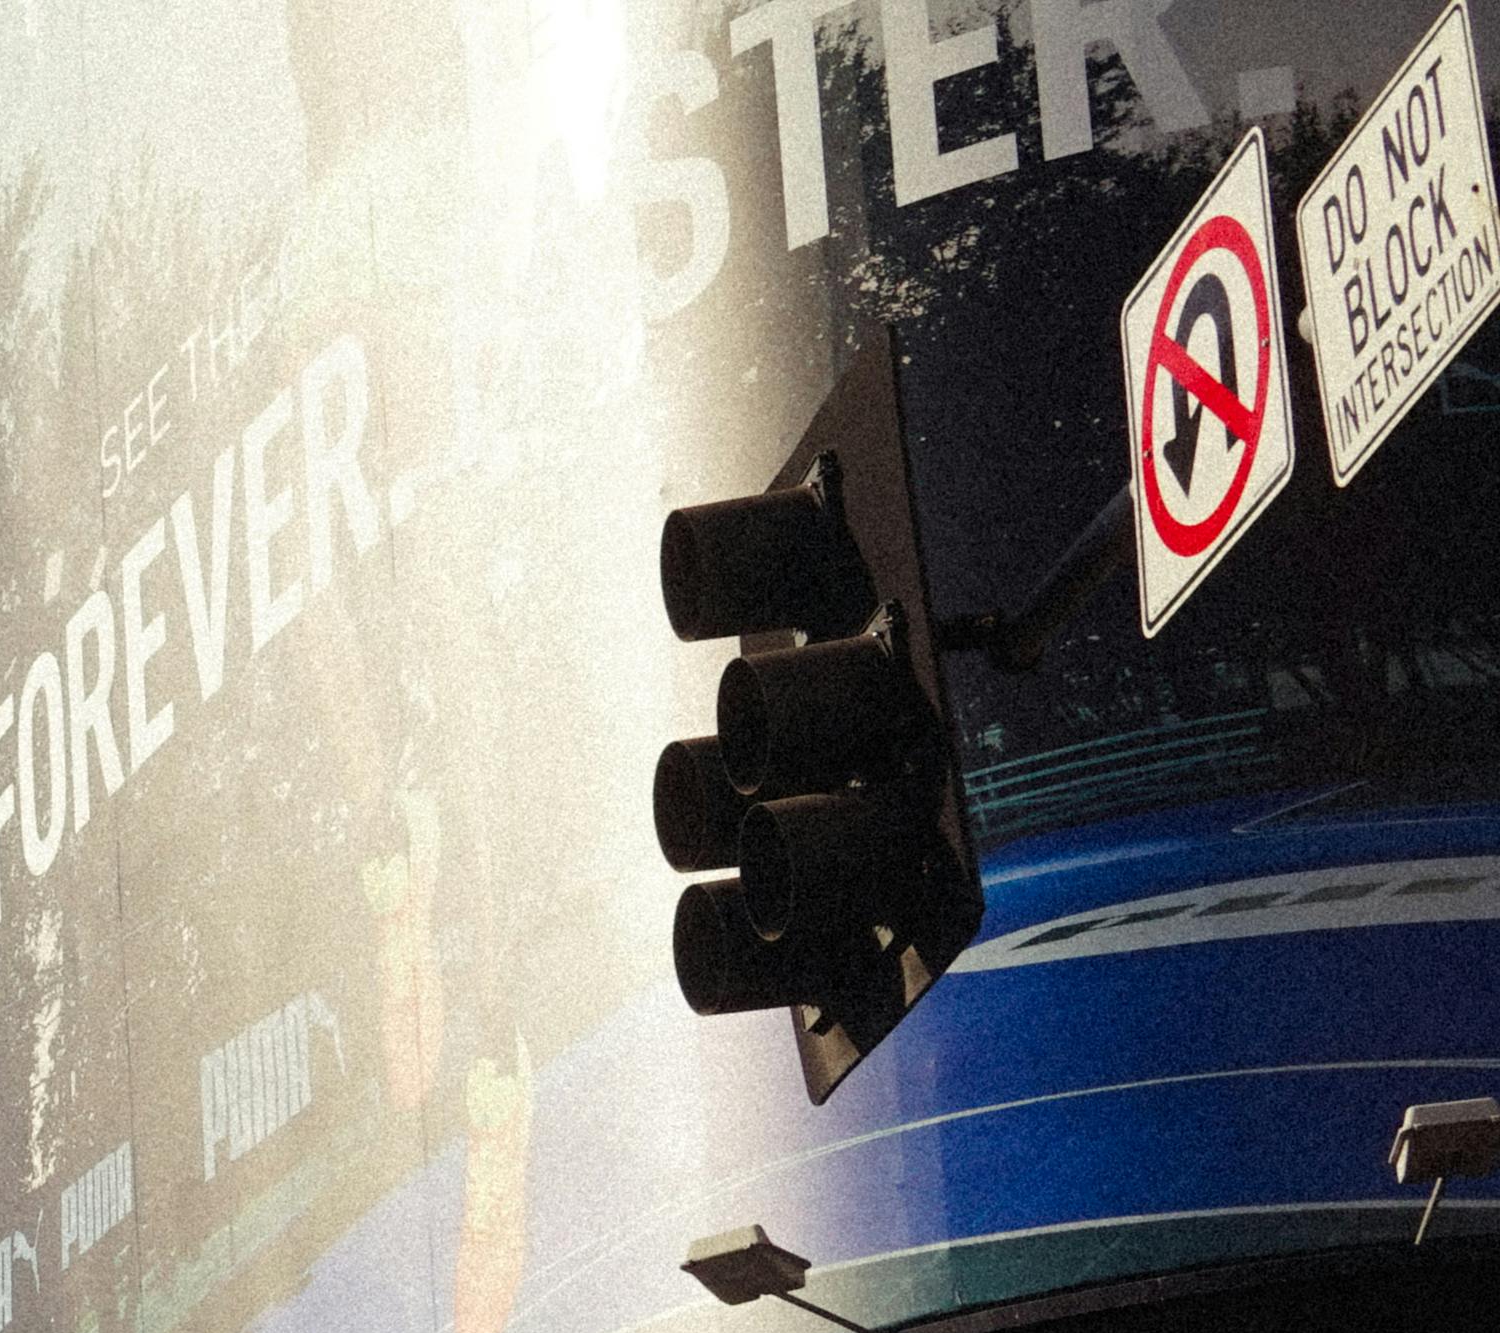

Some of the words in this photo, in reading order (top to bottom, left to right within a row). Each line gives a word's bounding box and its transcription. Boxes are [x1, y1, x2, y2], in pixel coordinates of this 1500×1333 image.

[1322, 163, 1368, 276] DO
[1381, 56, 1446, 201] NOT
[1343, 163, 1457, 360] BLOCK
[97, 362, 174, 499] SEE
[1334, 223, 1494, 453] INTERSECTION
